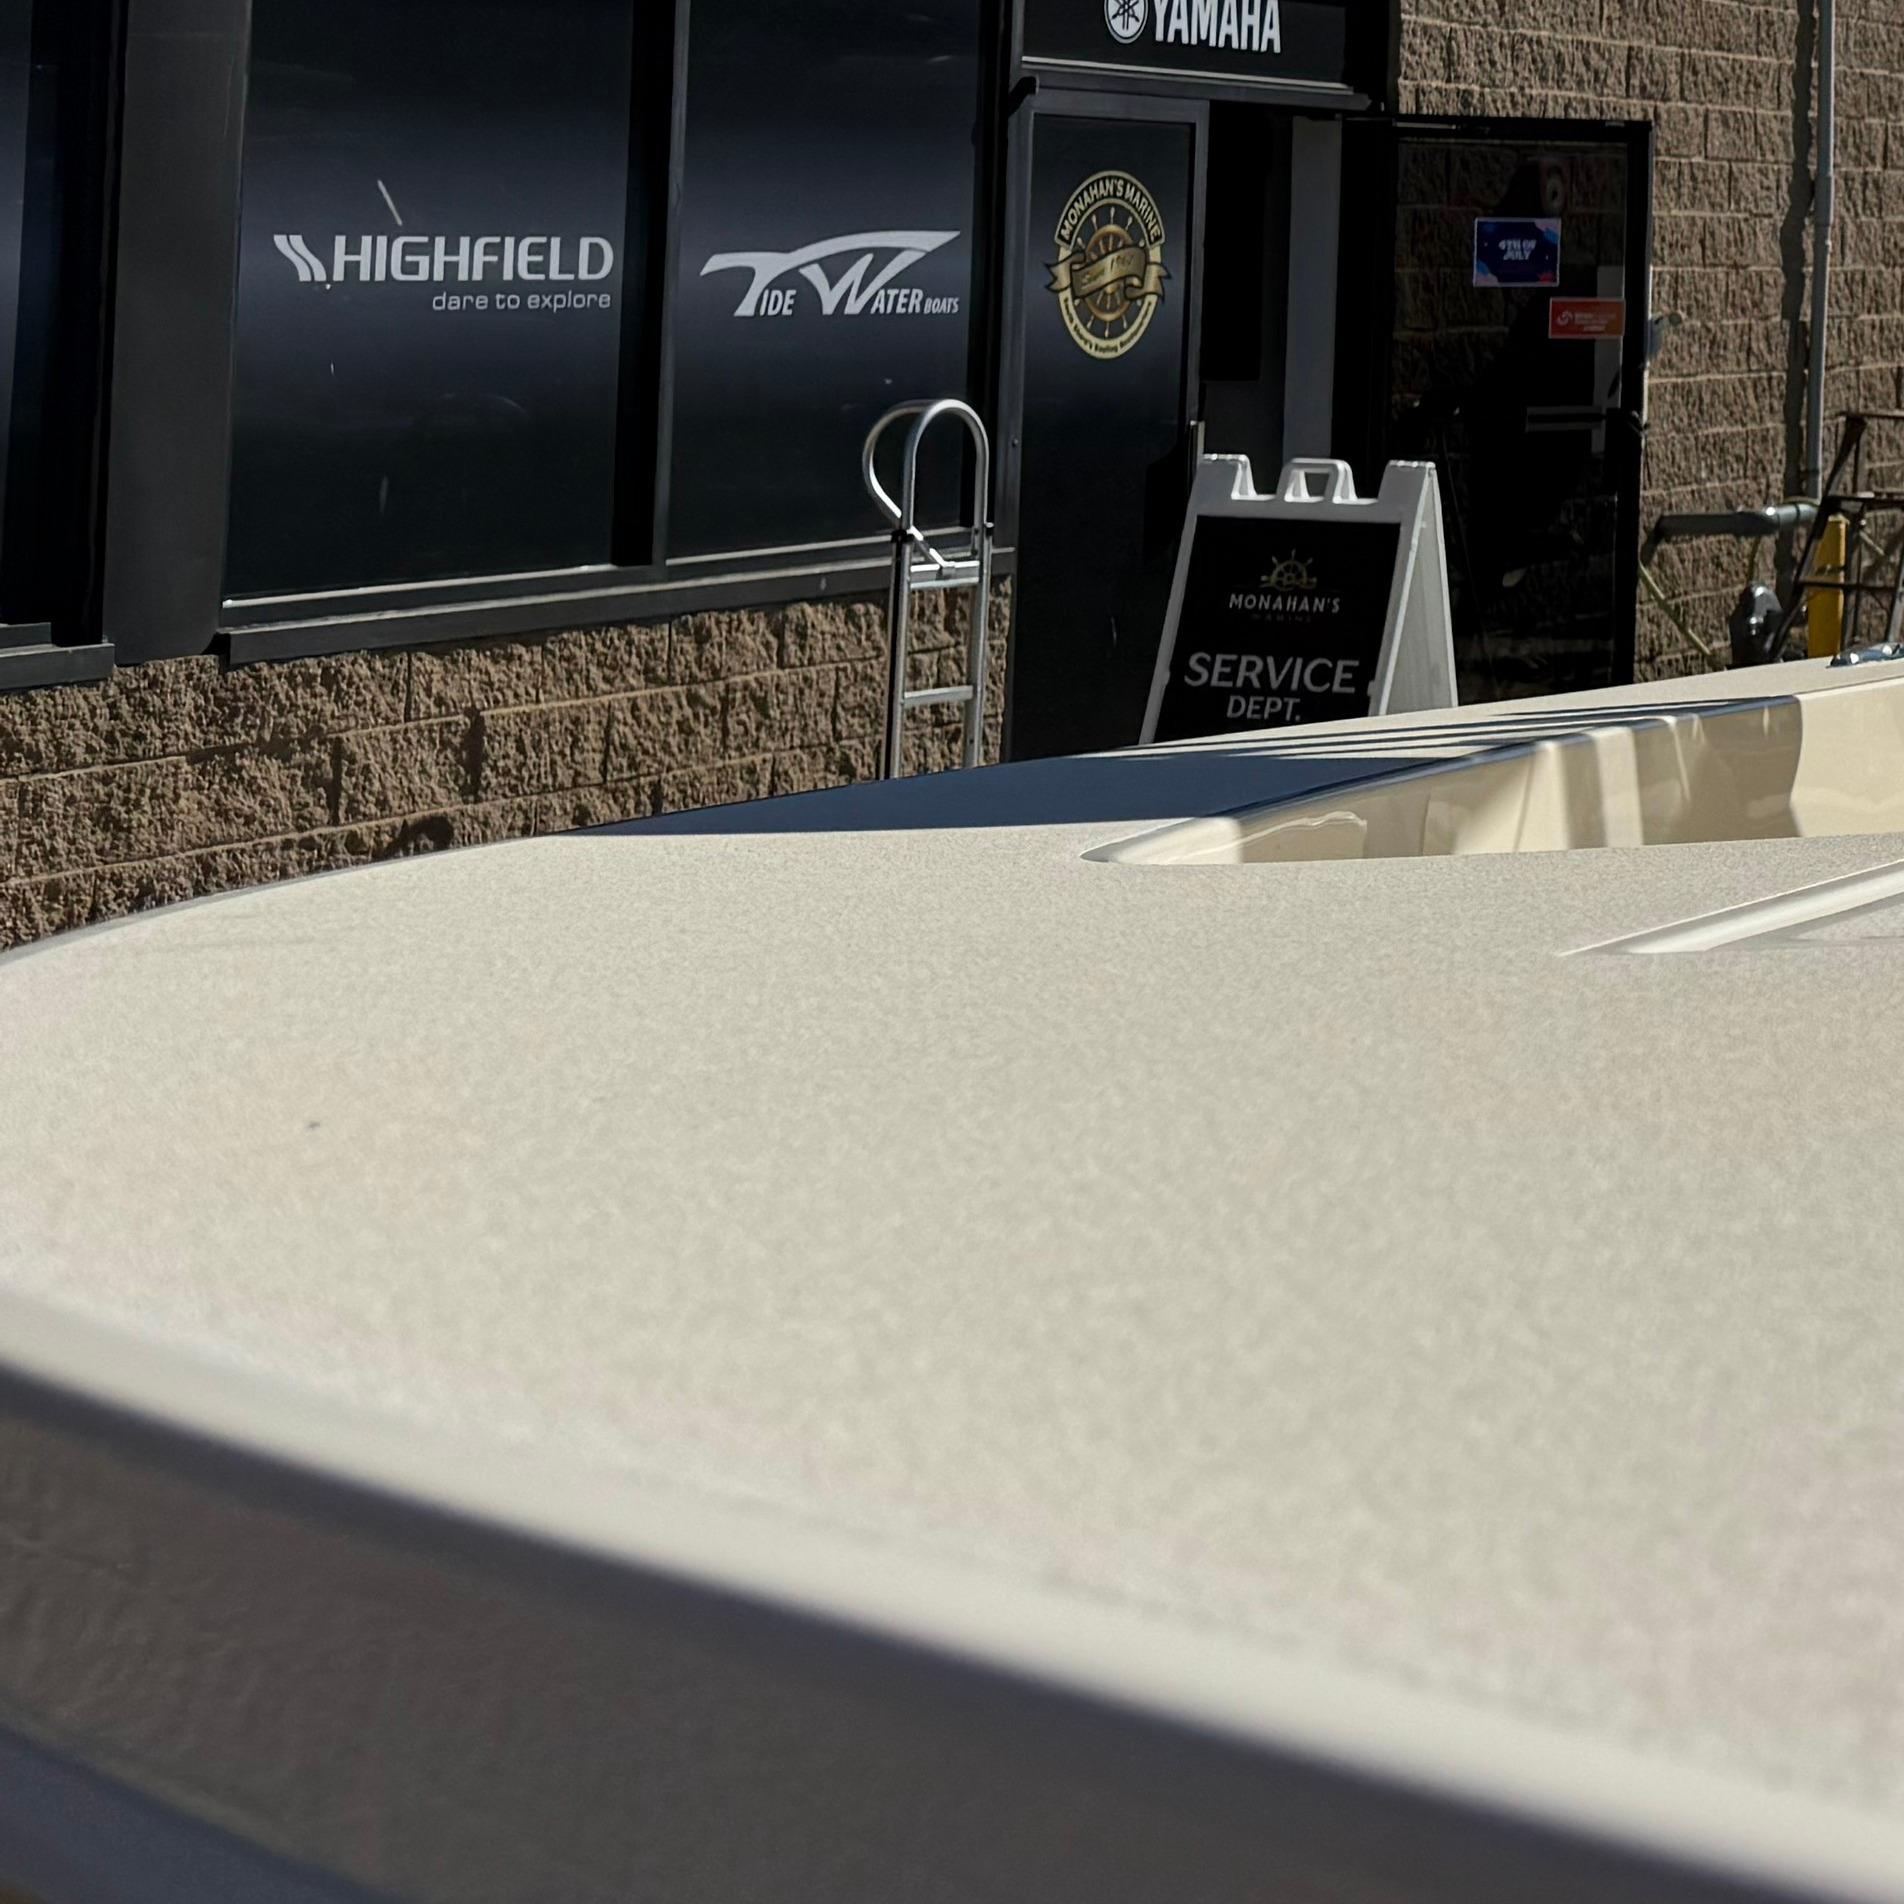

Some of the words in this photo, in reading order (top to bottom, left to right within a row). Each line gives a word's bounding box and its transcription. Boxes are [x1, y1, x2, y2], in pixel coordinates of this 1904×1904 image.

[1060, 178, 1124, 241] MONAHAN'S
[1124, 182, 1162, 242] MARINE
[332, 234, 615, 282] HIGHFIELD
[432, 292, 489, 311] dare
[495, 293, 520, 310] to
[527, 290, 611, 313] explore
[700, 251, 798, 317] TIDE
[798, 248, 928, 315] WATER
[923, 296, 960, 315] BOATS
[1228, 593, 1341, 614] MONAHAN'S
[1183, 651, 1360, 694] SERVICE
[1226, 694, 1301, 721] DEPT.
